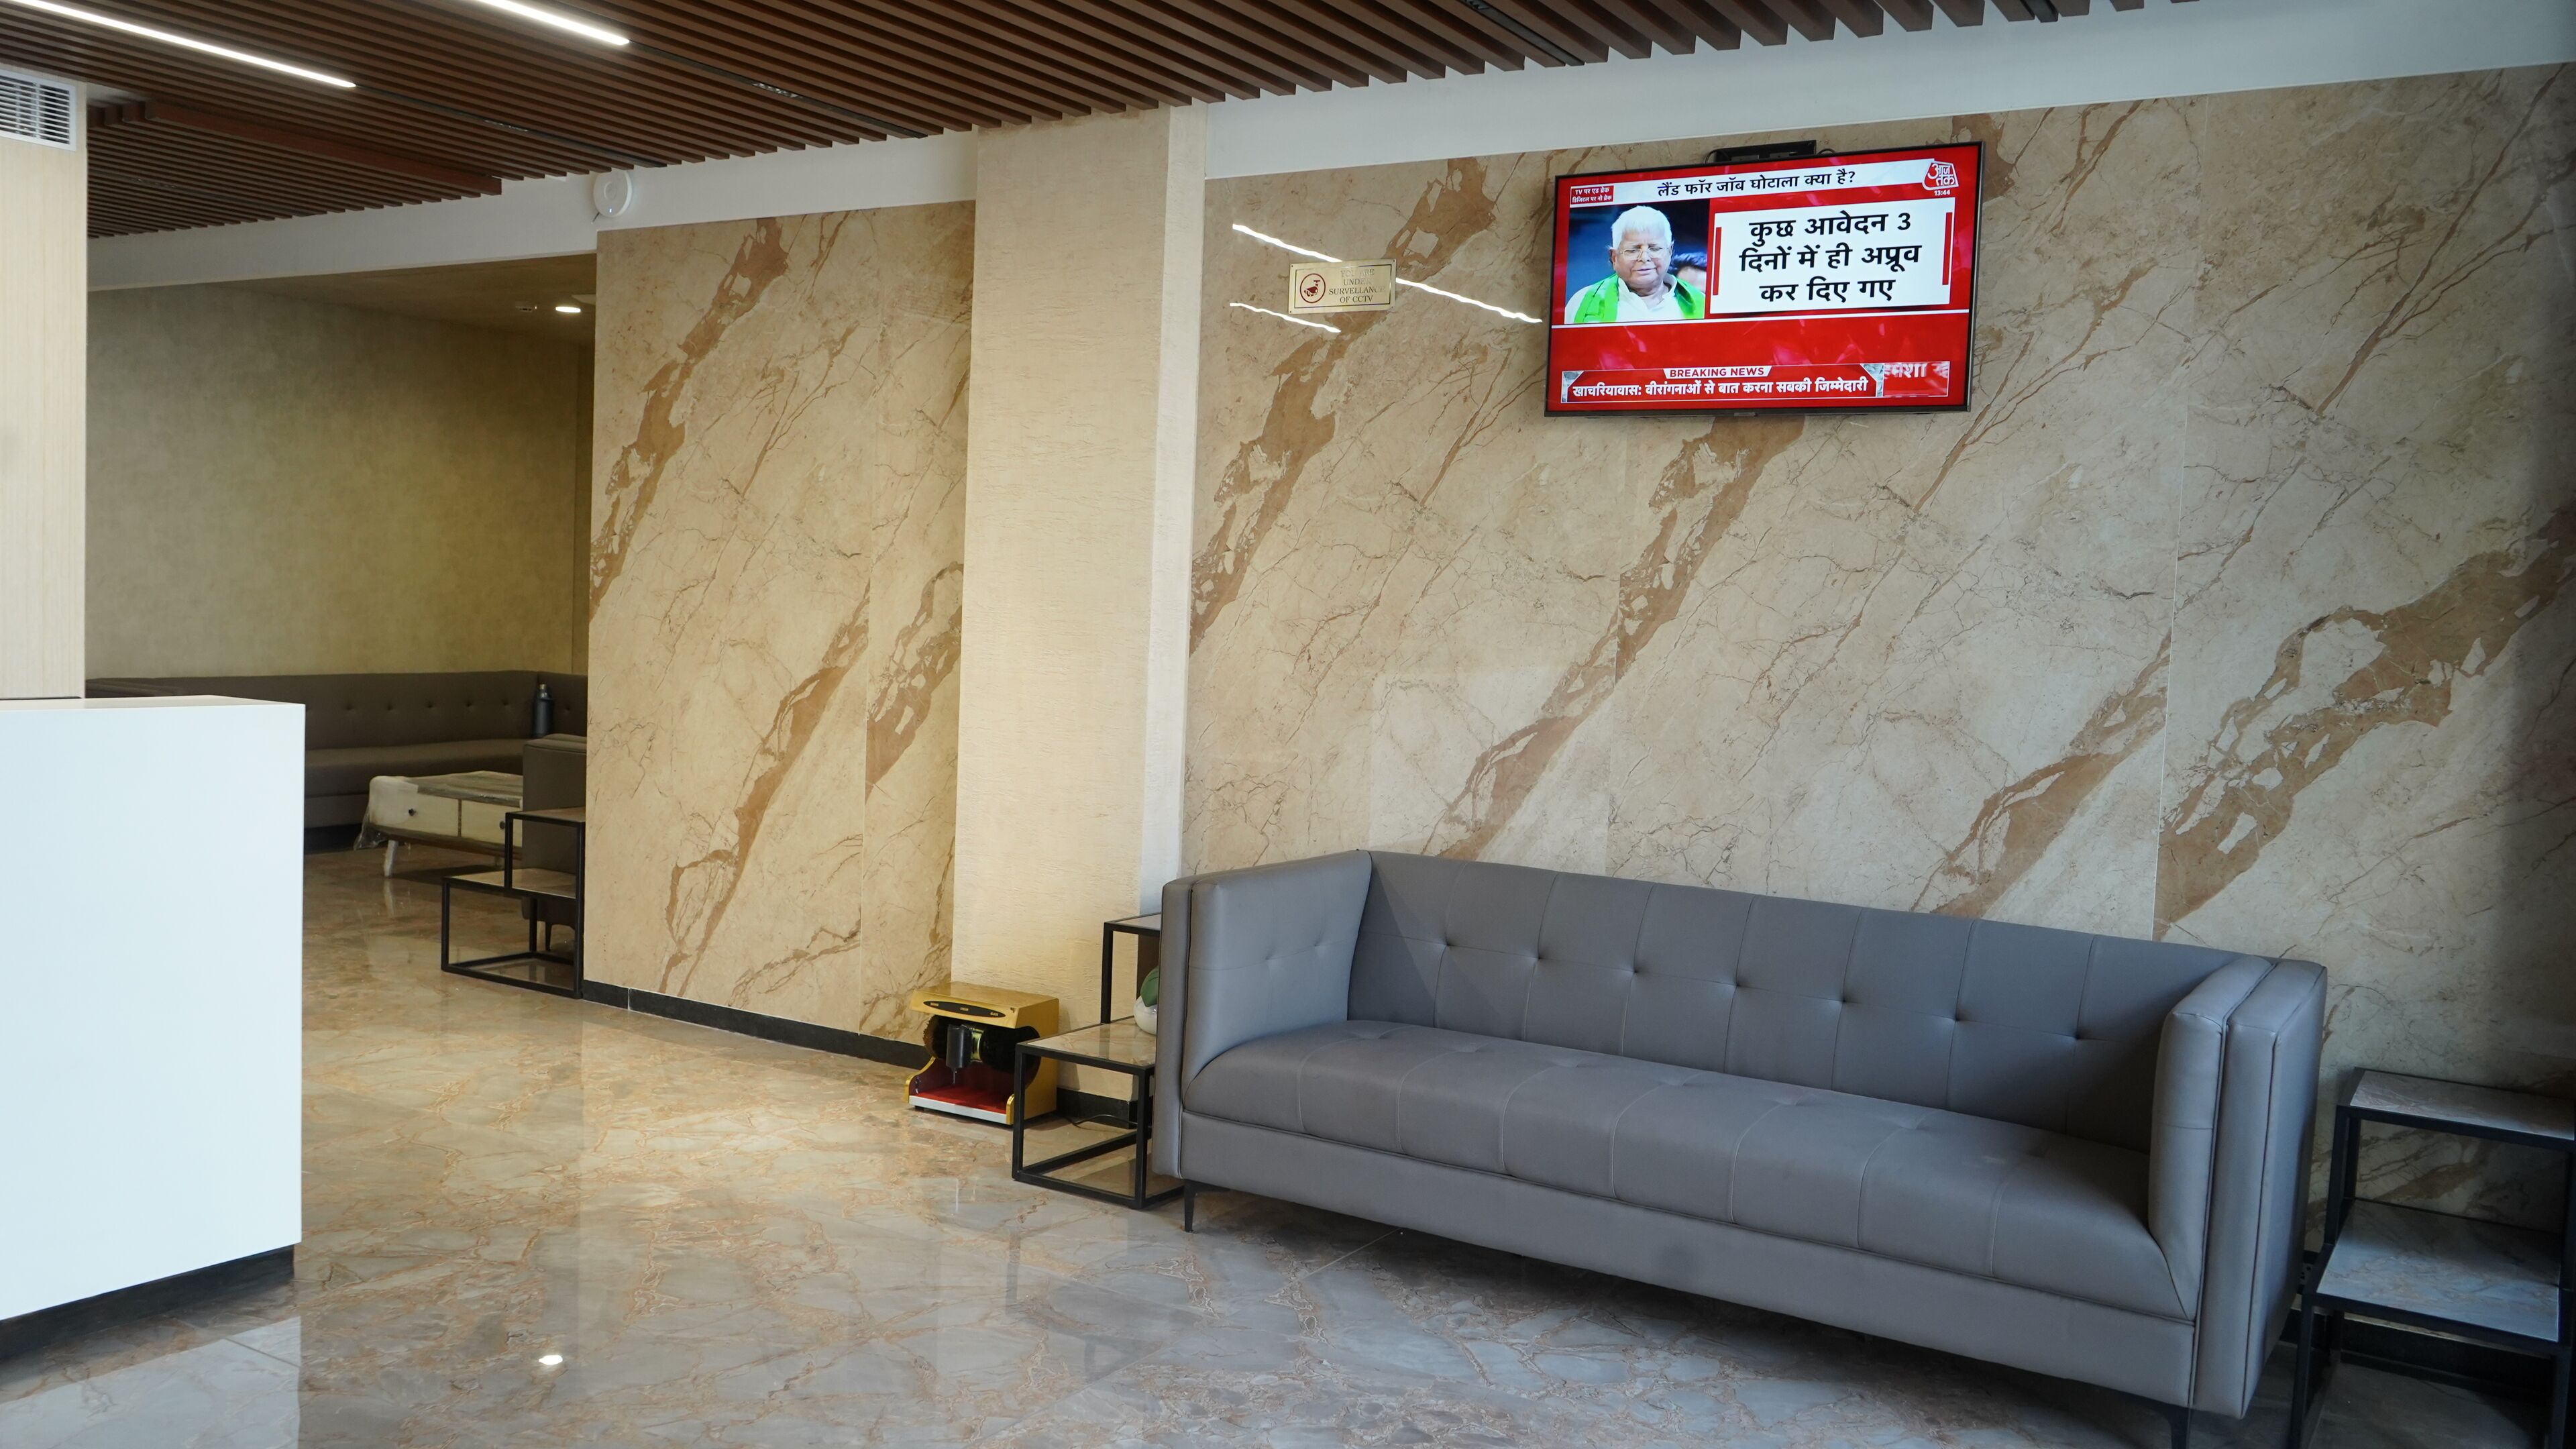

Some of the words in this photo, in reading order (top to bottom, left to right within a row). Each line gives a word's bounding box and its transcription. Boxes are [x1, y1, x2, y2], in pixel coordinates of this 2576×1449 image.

[1658, 181, 1681, 197] लैंड
[1684, 179, 1713, 195] फॉर
[1716, 176, 1746, 192] जॉब
[1750, 174, 1800, 189] घोटाला
[1804, 173, 1832, 186] क्या
[1836, 168, 1856, 184] है?
[1927, 163, 1951, 179] आज
[1749, 219, 1796, 247] कुछ
[1805, 210, 1888, 235] आवेदन
[1897, 213, 1911, 231] 3
[1739, 246, 1792, 272] दिनों
[1797, 244, 1821, 268] में
[1825, 242, 1853, 269] ही
[1861, 245, 1923, 272] अप्रूव
[1759, 284, 1799, 302] कर
[1807, 276, 1850, 303] दिए
[1858, 279, 1896, 302] गए
[1572, 382, 1642, 396] खाचरियावास:
[1646, 380, 1702, 395] वीरांगनाओं
[1704, 380, 1715, 394] से
[1719, 382, 1739, 394] बात
[1743, 382, 1773, 394] करना
[1776, 377, 1812, 392] सबकी
[1815, 376, 1868, 392] जिम्मेदारी
[1670, 369, 1727, 377] BREAKING
[1731, 368, 1764, 376] NEWS
